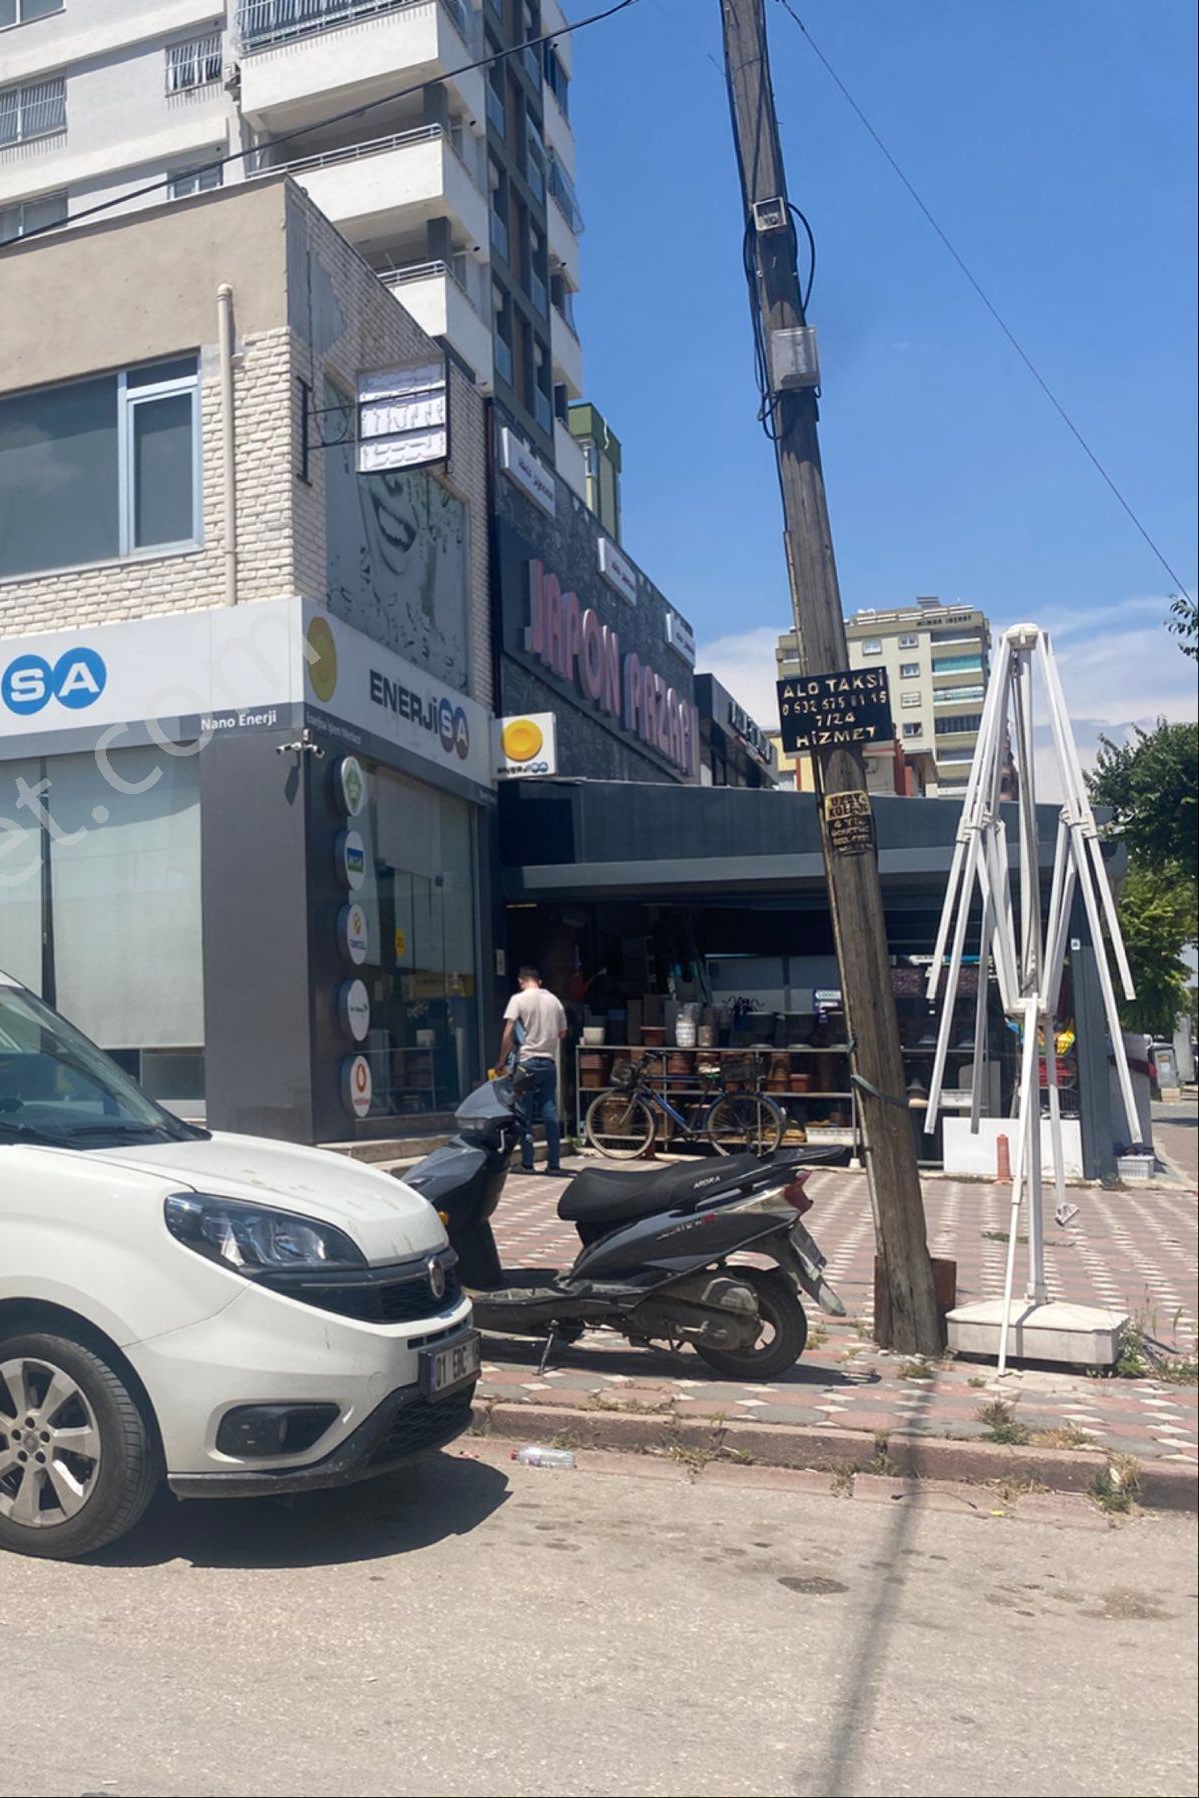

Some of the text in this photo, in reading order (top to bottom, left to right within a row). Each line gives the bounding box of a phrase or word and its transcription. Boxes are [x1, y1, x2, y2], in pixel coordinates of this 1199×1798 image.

[783, 668, 884, 698] ALO TAKSİ
[202, 710, 277, 731] Nano Enerji
[815, 712, 856, 727] 7/24
[796, 726, 876, 748] HİZMET
